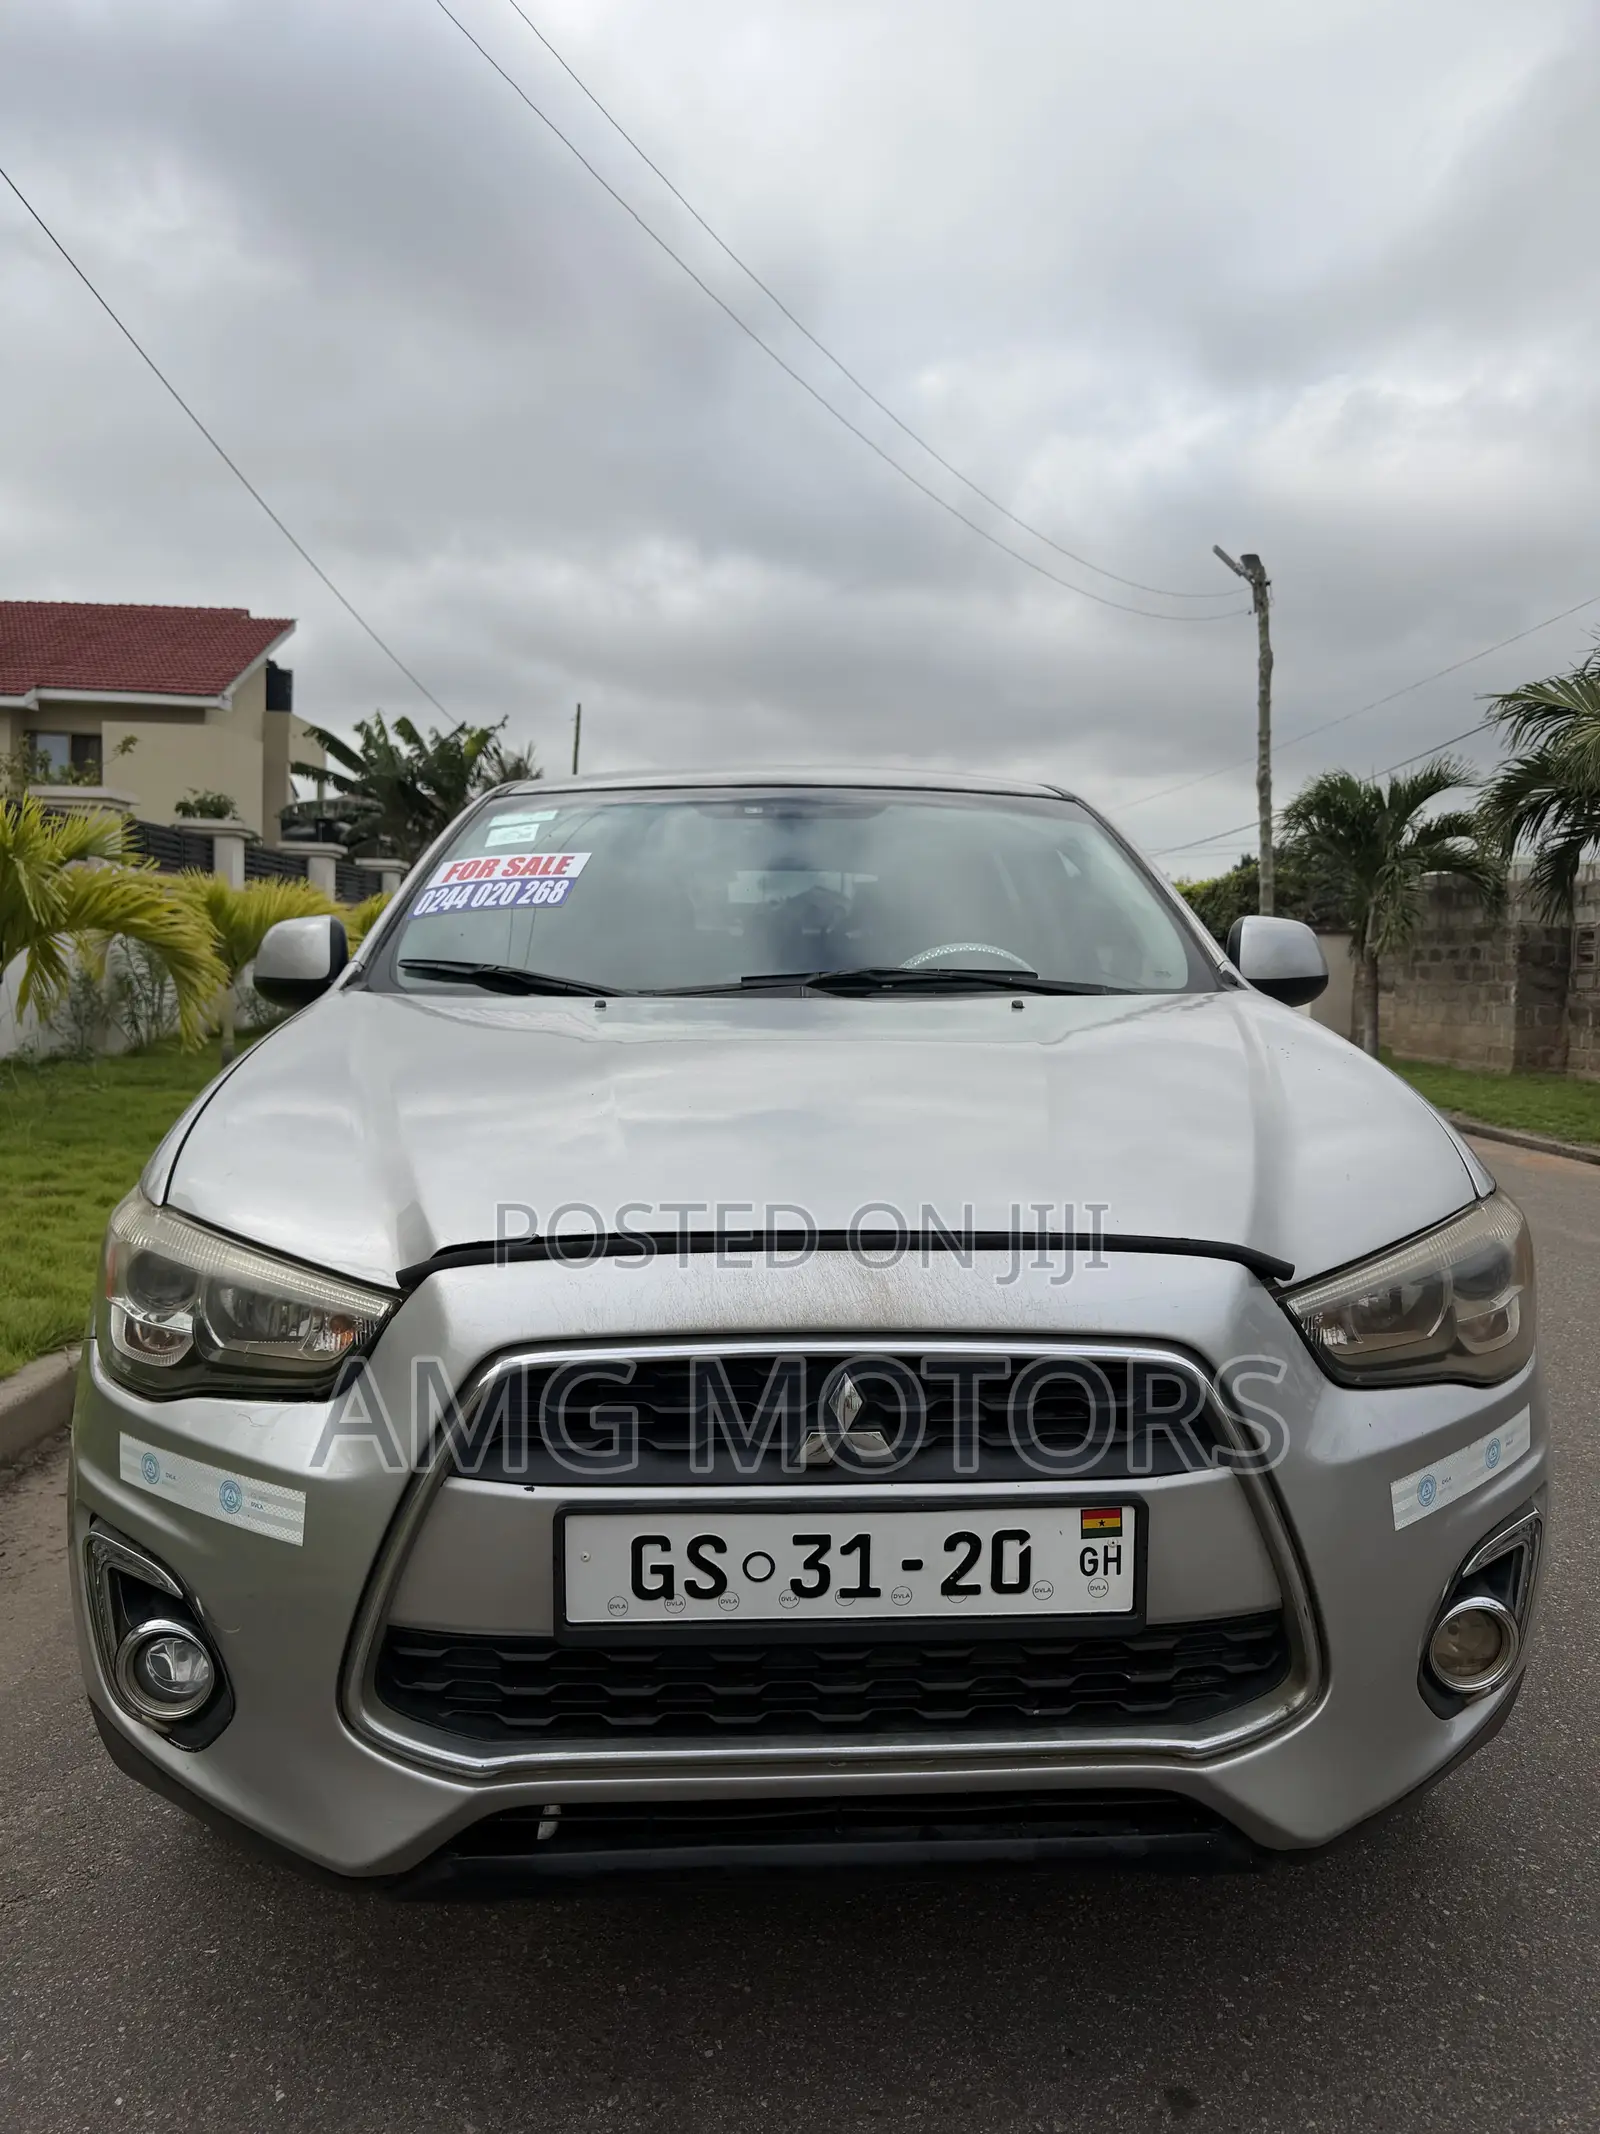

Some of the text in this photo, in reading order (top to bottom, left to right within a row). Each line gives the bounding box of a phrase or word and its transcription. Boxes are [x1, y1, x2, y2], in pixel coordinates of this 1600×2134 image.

[441, 856, 575, 883] FOR SALE
[413, 880, 569, 916] 0244 020 268
[1079, 1544, 1121, 1577] GH
[631, 1534, 728, 1600] GS
[1034, 1586, 1052, 1594] DVLA
[1089, 1584, 1107, 1592] DVLA
[781, 1595, 798, 1603] DVLA
[893, 1592, 911, 1600] DVLA
[666, 1599, 684, 1607] DVLA
[720, 1597, 738, 1605] DVLA
[609, 1602, 627, 1610] DVLA
